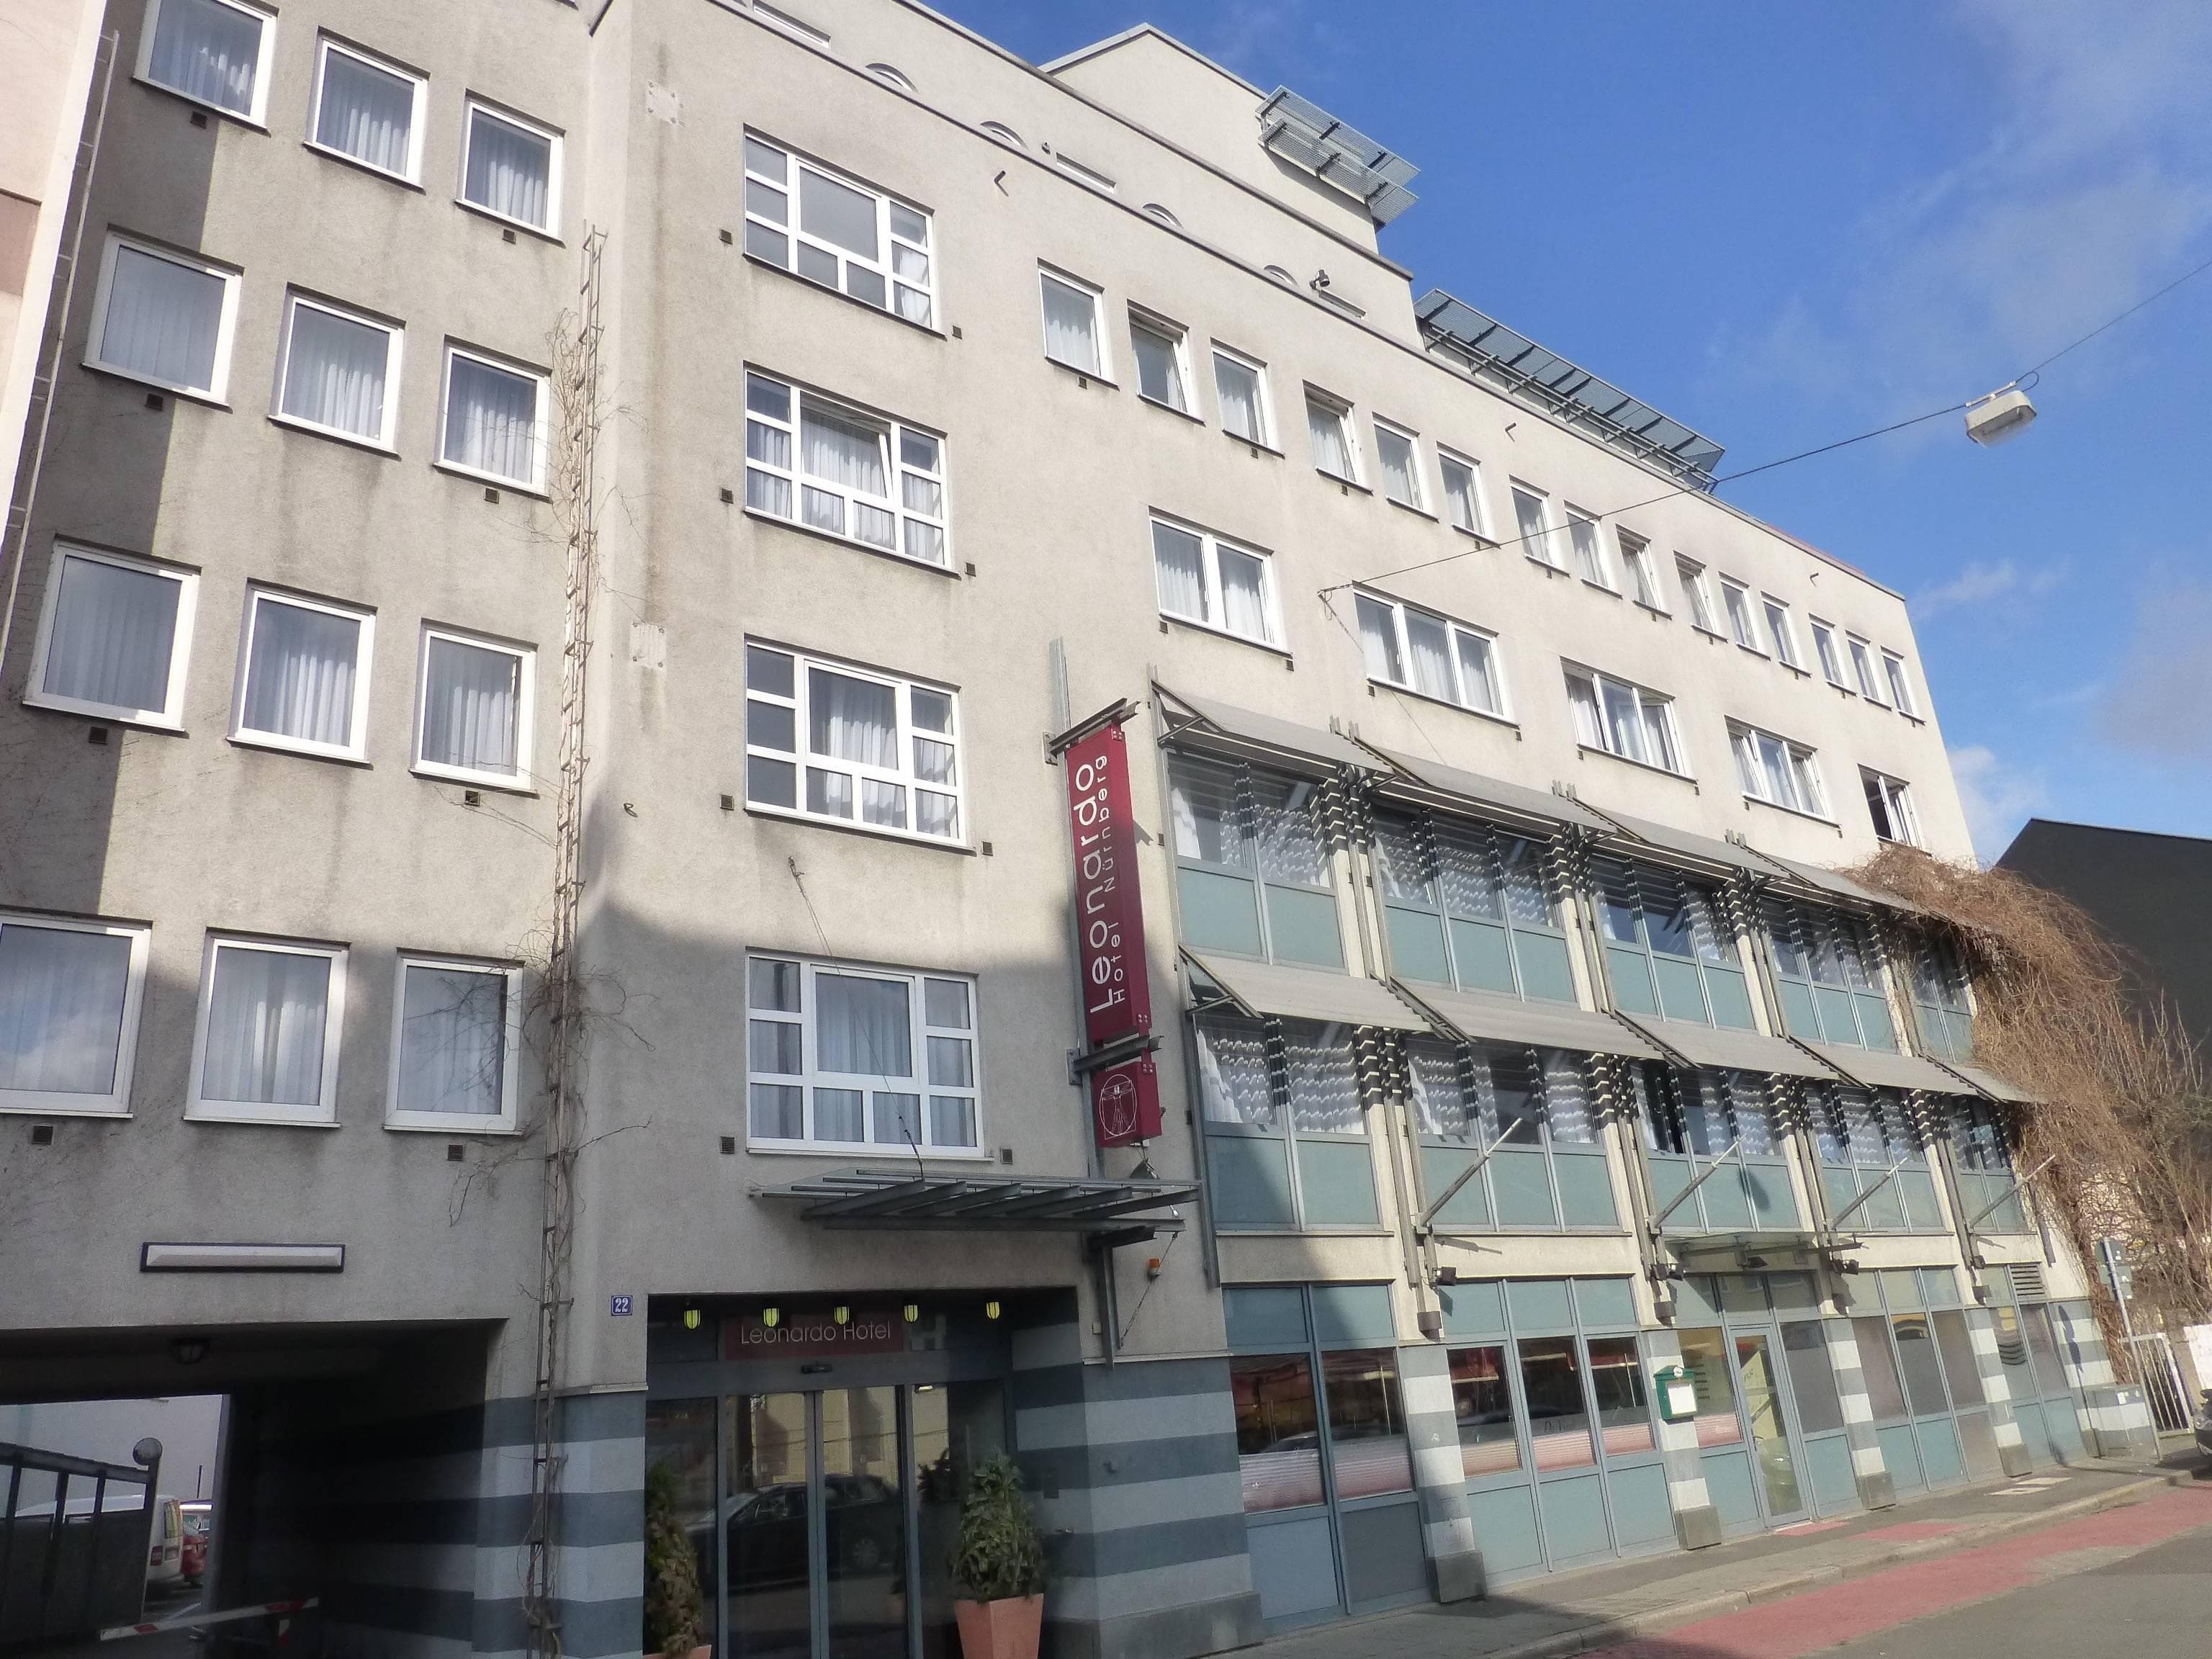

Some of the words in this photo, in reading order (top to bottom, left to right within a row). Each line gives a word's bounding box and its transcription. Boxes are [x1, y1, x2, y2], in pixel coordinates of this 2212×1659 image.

[1095, 755, 1115, 892] Nürnberg
[1073, 763, 1114, 1013] Leonardo
[1108, 922, 1125, 1004] Hotel
[615, 1298, 629, 1313] 22
[741, 1322, 836, 1344] Leonardo
[843, 1321, 891, 1340] Hotel
